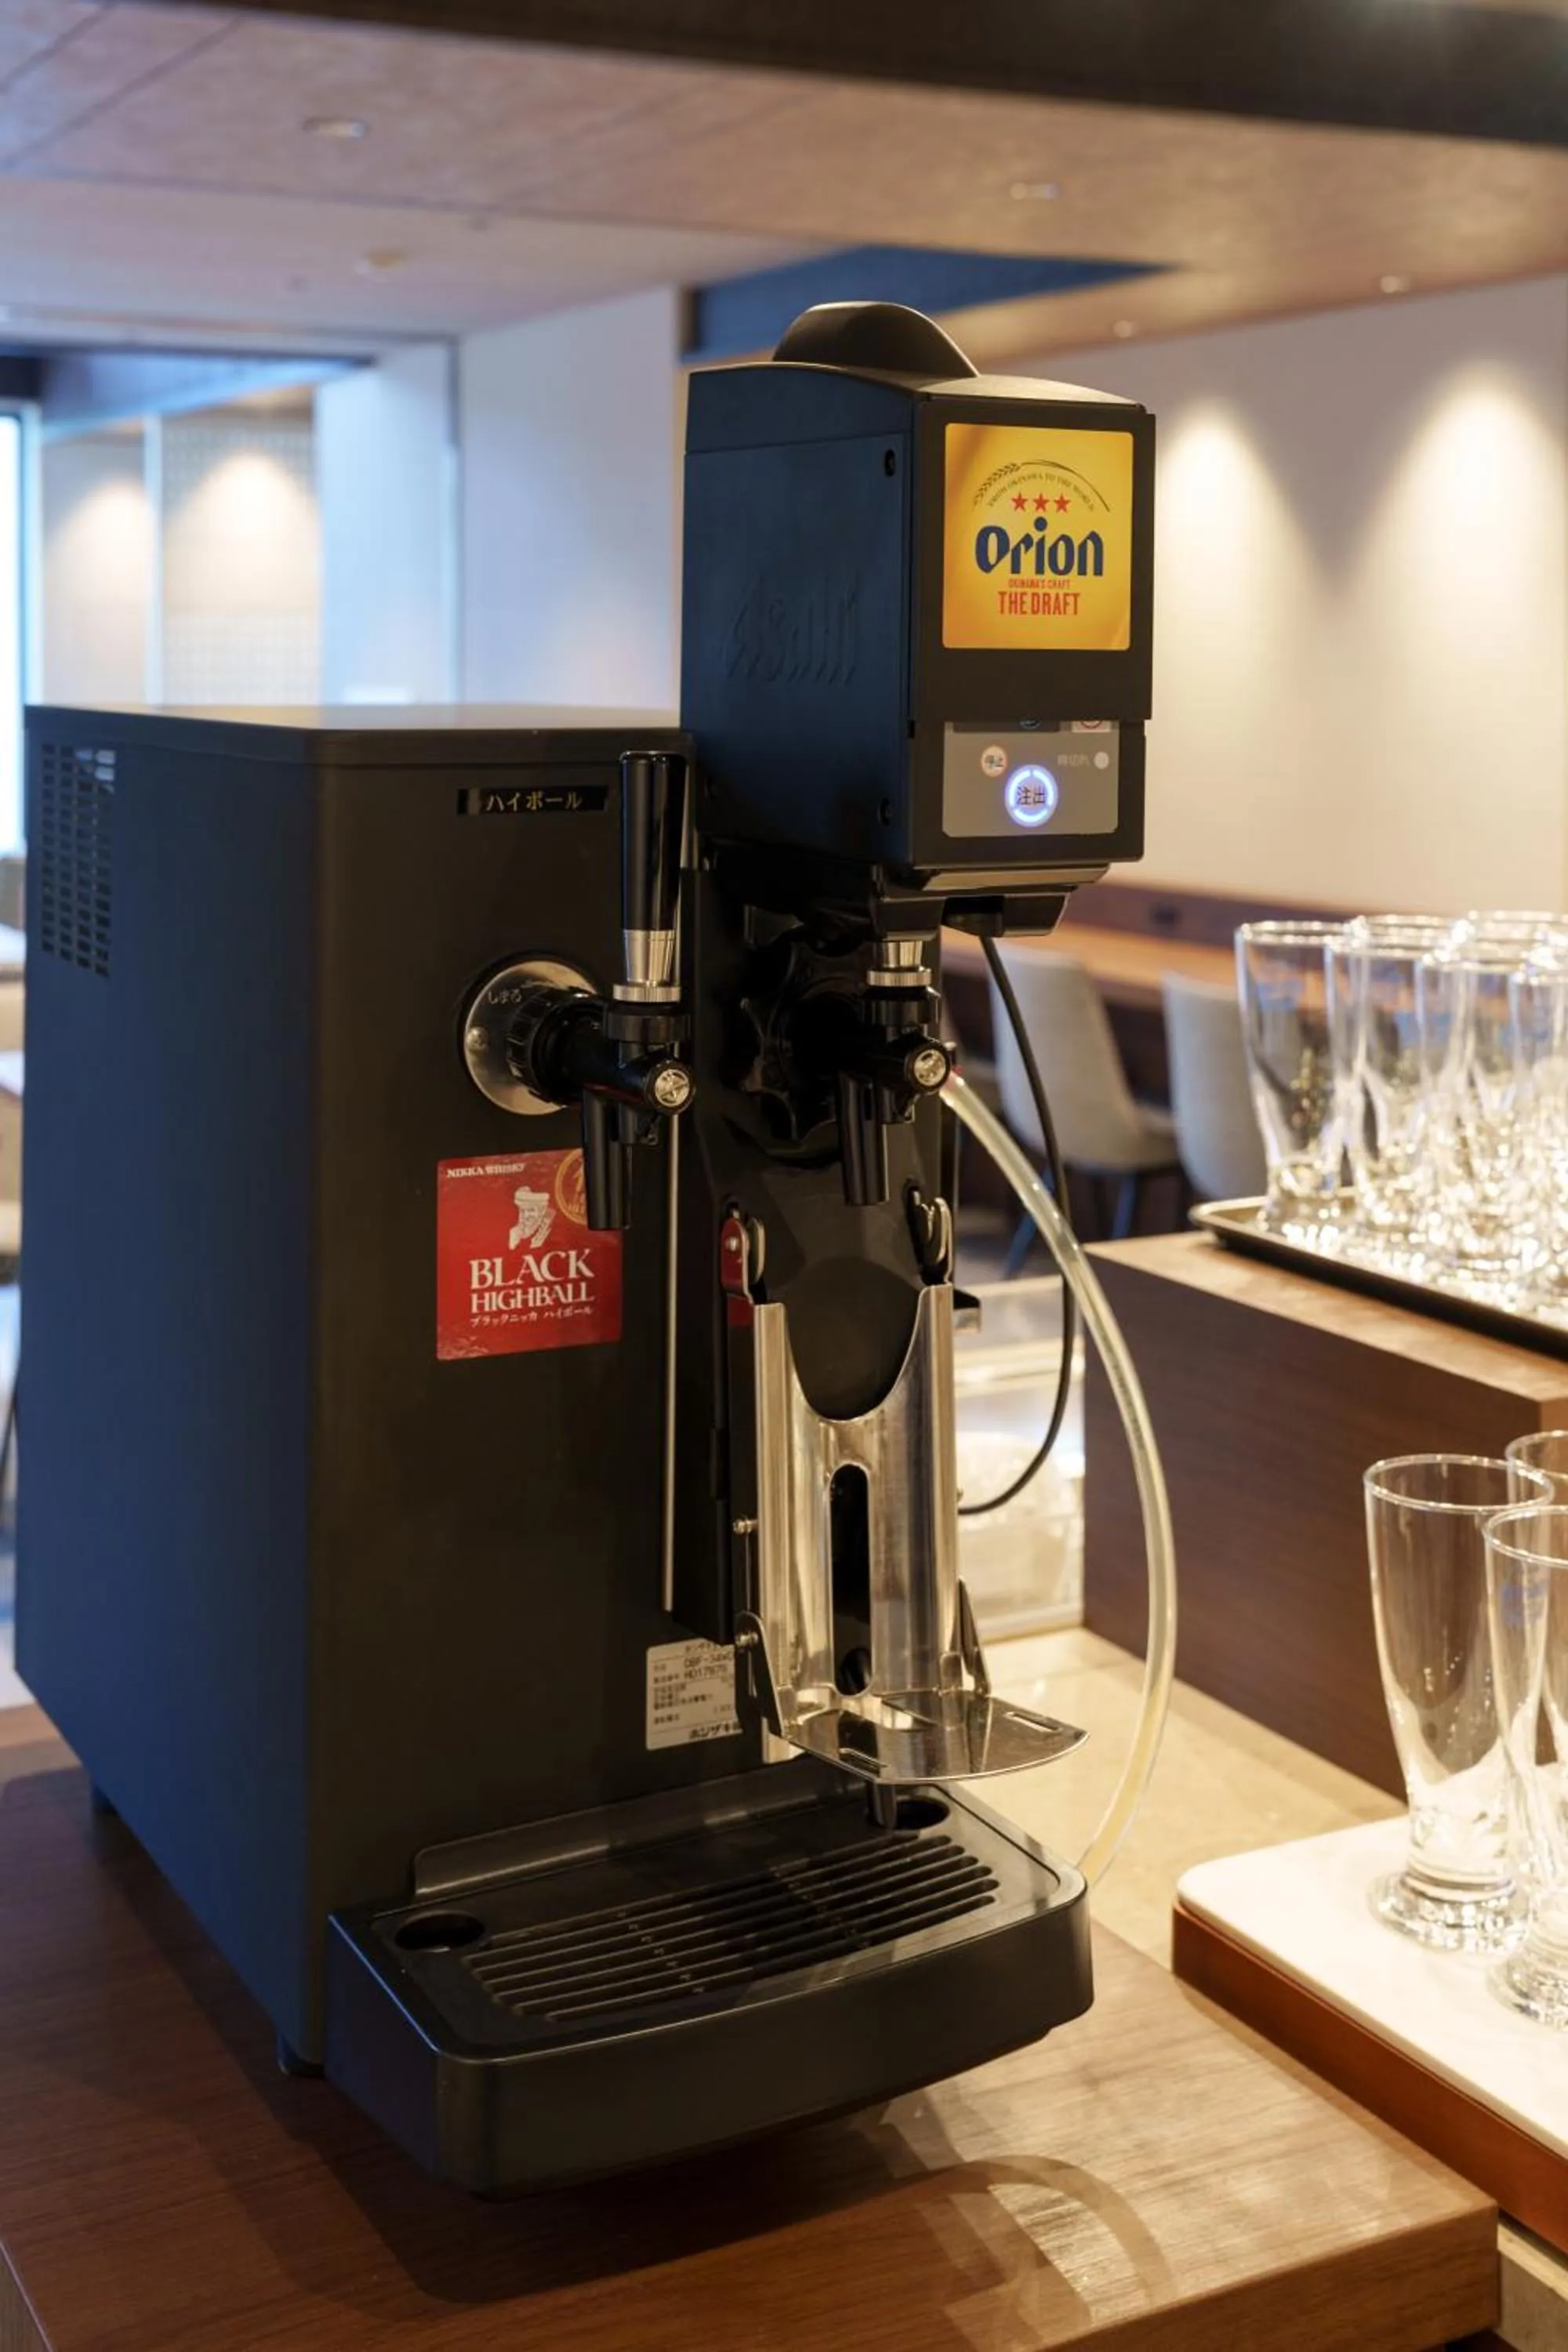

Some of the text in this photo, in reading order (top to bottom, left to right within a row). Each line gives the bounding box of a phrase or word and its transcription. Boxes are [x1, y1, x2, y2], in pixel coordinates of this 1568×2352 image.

[975, 516, 1104, 576] Orion
[997, 590, 1080, 615] THE DRAFT
[486, 790, 583, 812] ハイボール
[1017, 785, 1046, 806] 注出
[488, 989, 522, 1005] しまる
[446, 1163, 527, 1178] NIKKA WHISKY
[469, 1248, 595, 1290] BLACK
[470, 1281, 595, 1314] HIGHBALL
